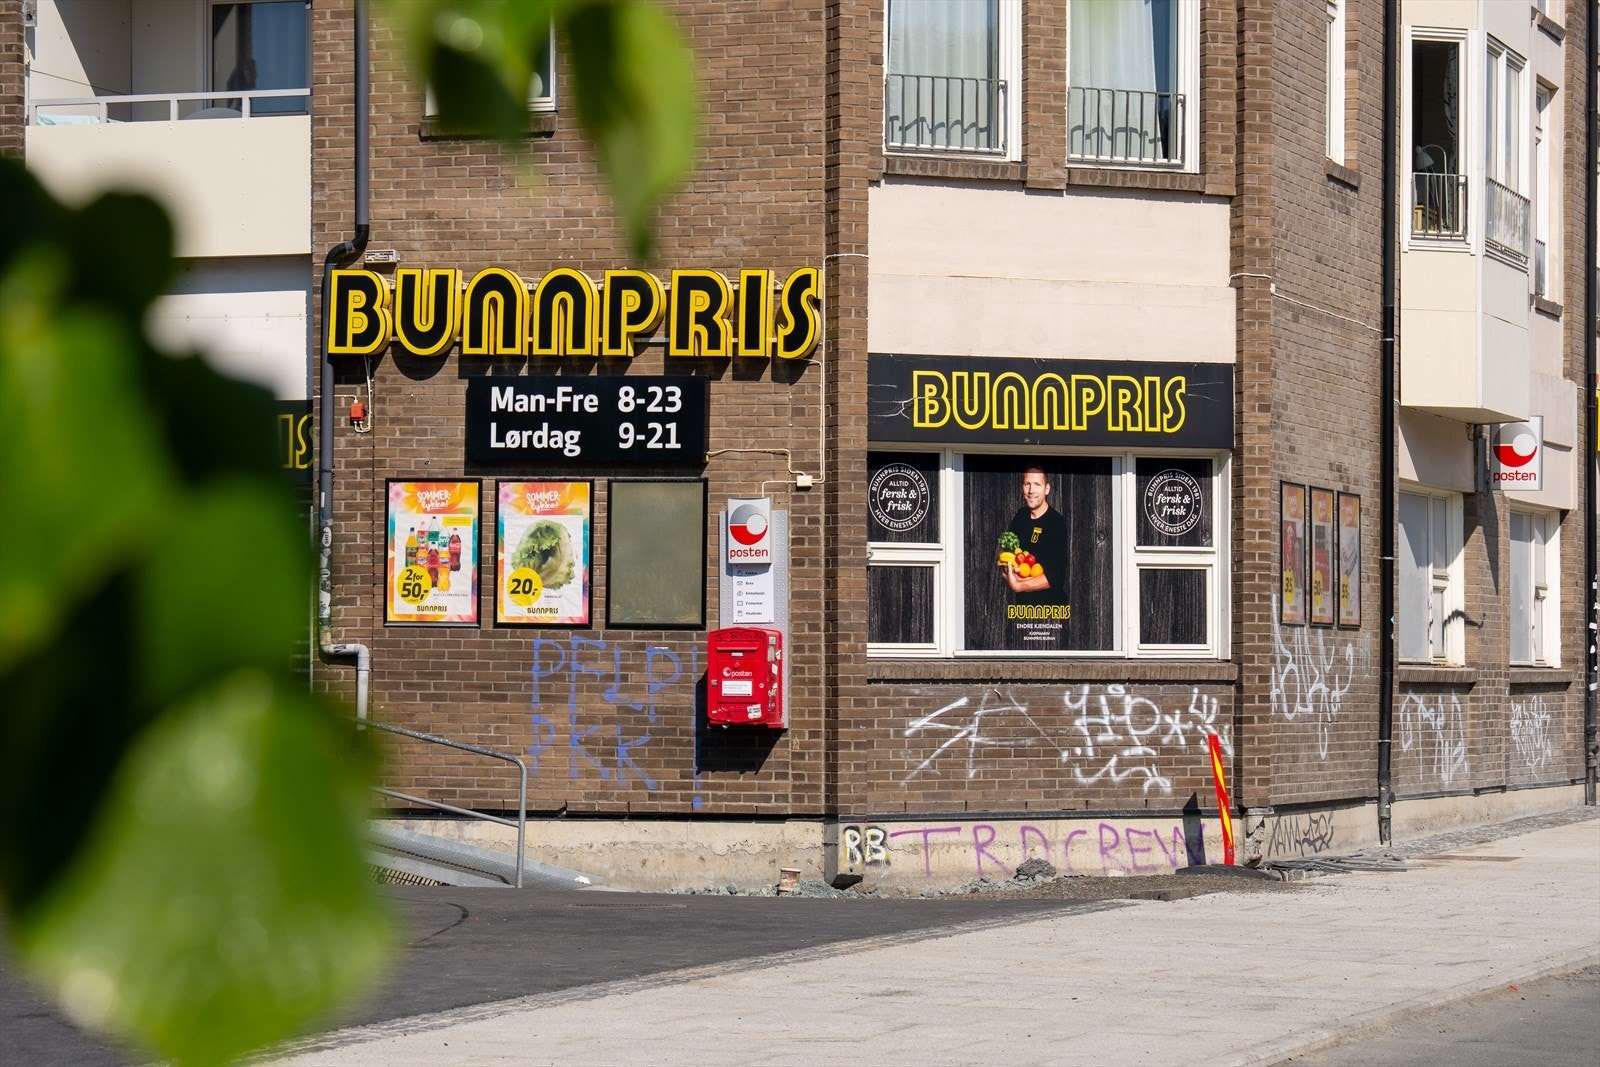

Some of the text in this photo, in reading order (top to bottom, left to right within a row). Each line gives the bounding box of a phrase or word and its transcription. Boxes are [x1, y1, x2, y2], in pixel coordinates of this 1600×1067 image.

[328, 267, 823, 360] BUNNPRIS
[490, 386, 682, 413] Man-Fre 8-23
[912, 370, 1187, 434] BUNNPRIS
[490, 422, 682, 457] Lørdag 9-21
[872, 466, 927, 495] BUNNPRIS SIDEN 1981
[1493, 470, 1537, 483] posten
[880, 488, 917, 500] fersk &
[1147, 472, 1174, 497] BUNNPRIS
[1191, 485, 1200, 500] 1981
[885, 500, 912, 512] frisk
[1156, 493, 1191, 505] fersk &
[874, 508, 924, 529] HVER ENESTE DAG
[1161, 505, 1187, 517] frisk
[1150, 513, 1197, 533] HVER ENESTE DAG
[729, 547, 769, 560] posten
[404, 569, 424, 582] 2 for
[401, 583, 429, 601] 50,-
[510, 578, 538, 596] 20,-
[1007, 605, 1071, 619] BUNNPRIS
